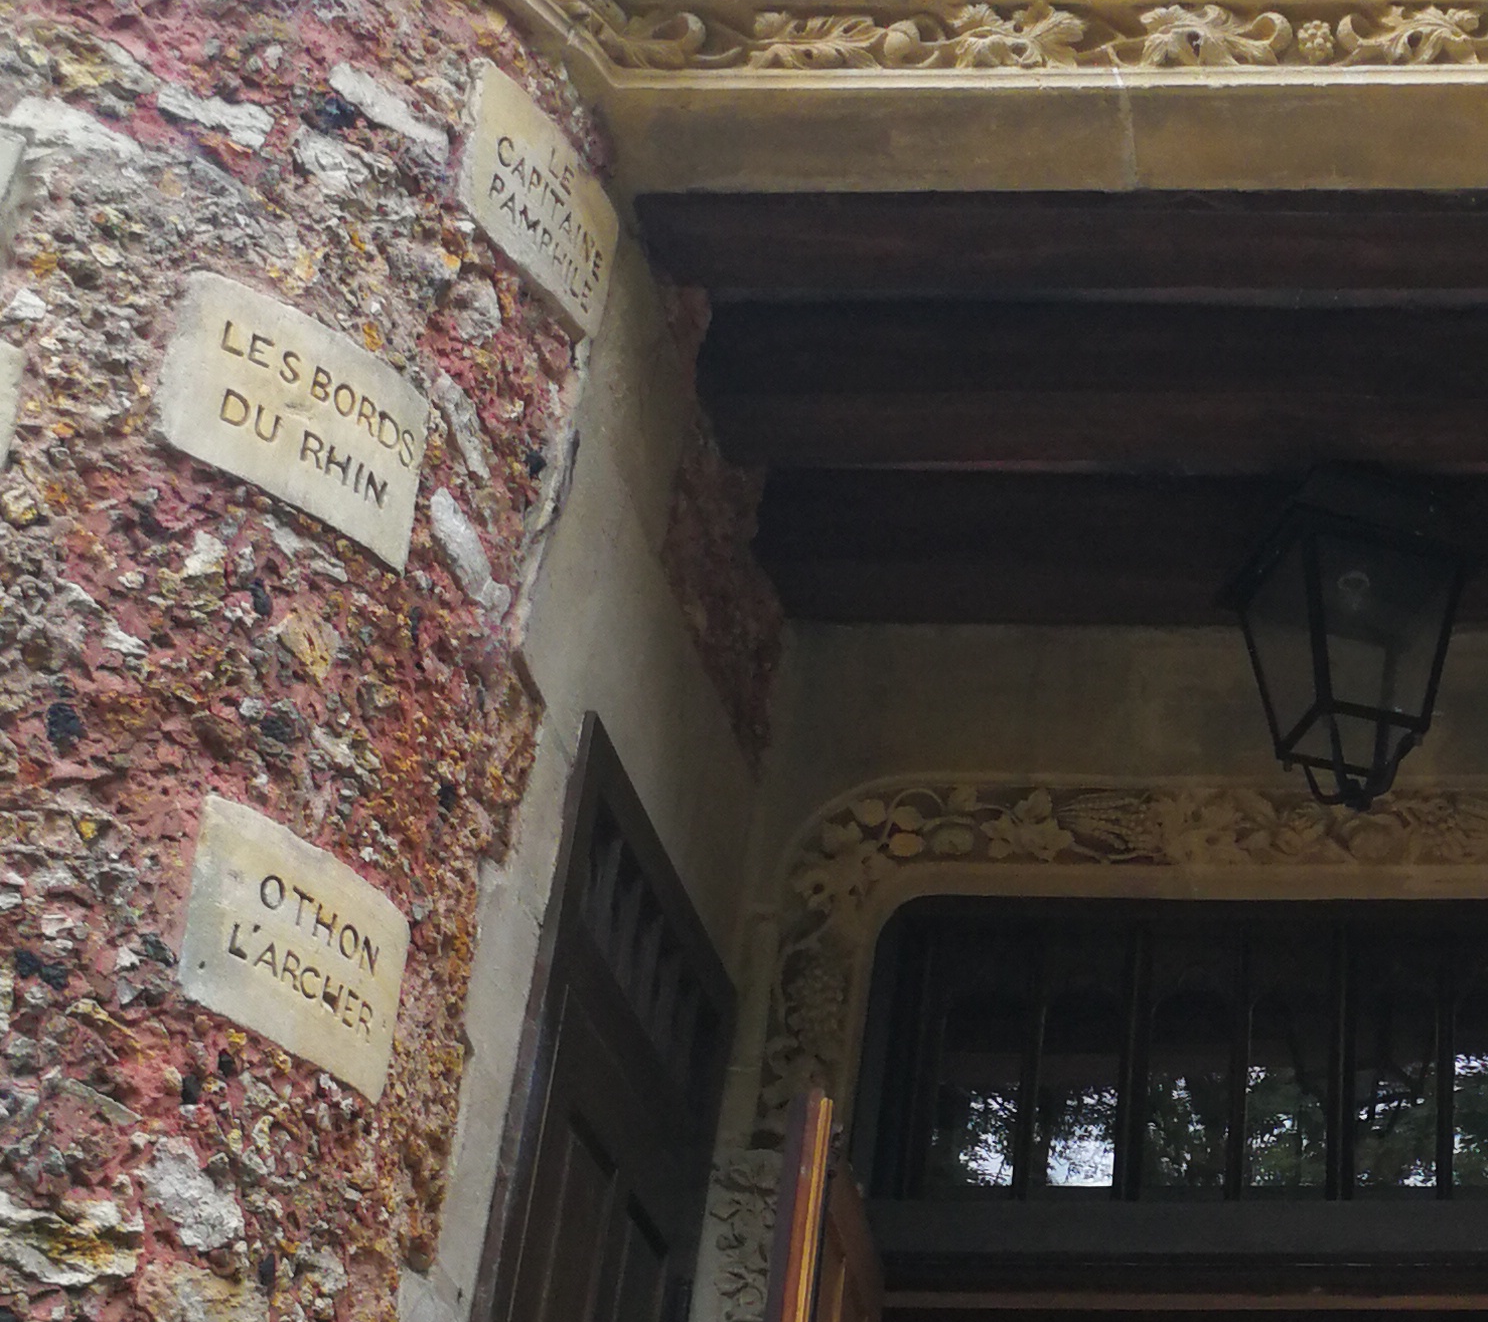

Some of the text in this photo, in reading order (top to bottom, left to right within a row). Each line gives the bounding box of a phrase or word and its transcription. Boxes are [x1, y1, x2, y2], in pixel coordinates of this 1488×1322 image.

[497, 135, 604, 283] CAPITAINE
[549, 147, 575, 197] LE
[488, 172, 594, 315] PAMPHILE
[220, 319, 416, 469] LES BORDS
[220, 388, 389, 510] DU RHIN
[228, 923, 375, 1038] L'ARCHER
[260, 874, 381, 977] OTHON
